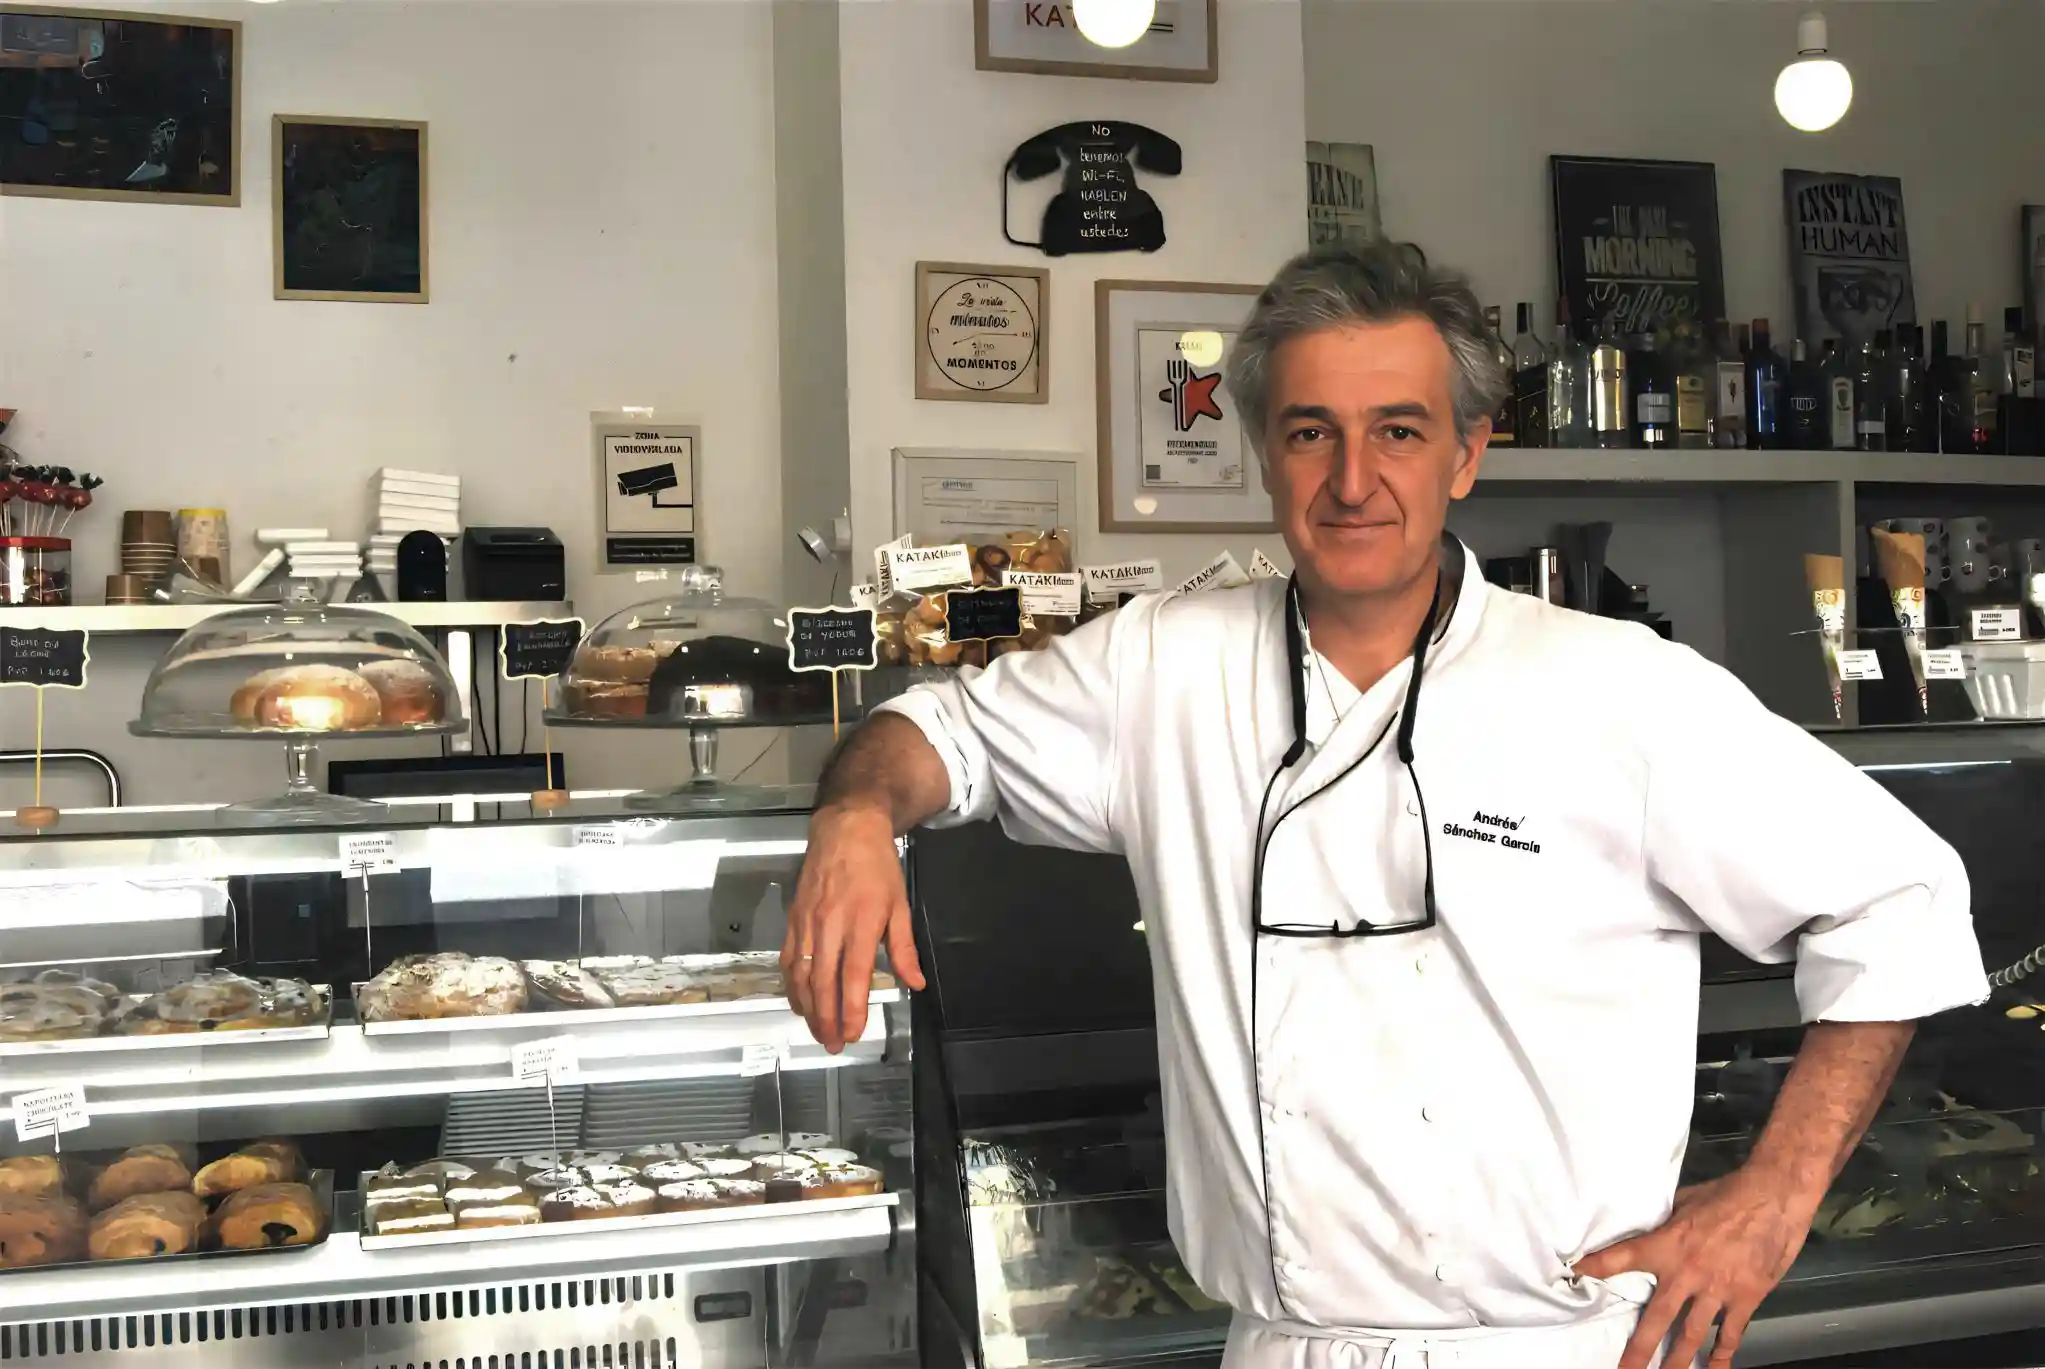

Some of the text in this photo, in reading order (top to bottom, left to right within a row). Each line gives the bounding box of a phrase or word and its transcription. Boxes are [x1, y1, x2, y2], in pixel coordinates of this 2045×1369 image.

[1798, 183, 1898, 228] INSTANT
[1582, 235, 1697, 277] MORNING
[1800, 225, 1898, 256] HUMAN
[946, 358, 1017, 371] MOMENTOS
[1009, 574, 1057, 586] KATAKI
[1443, 822, 1541, 854] Sánchez García
